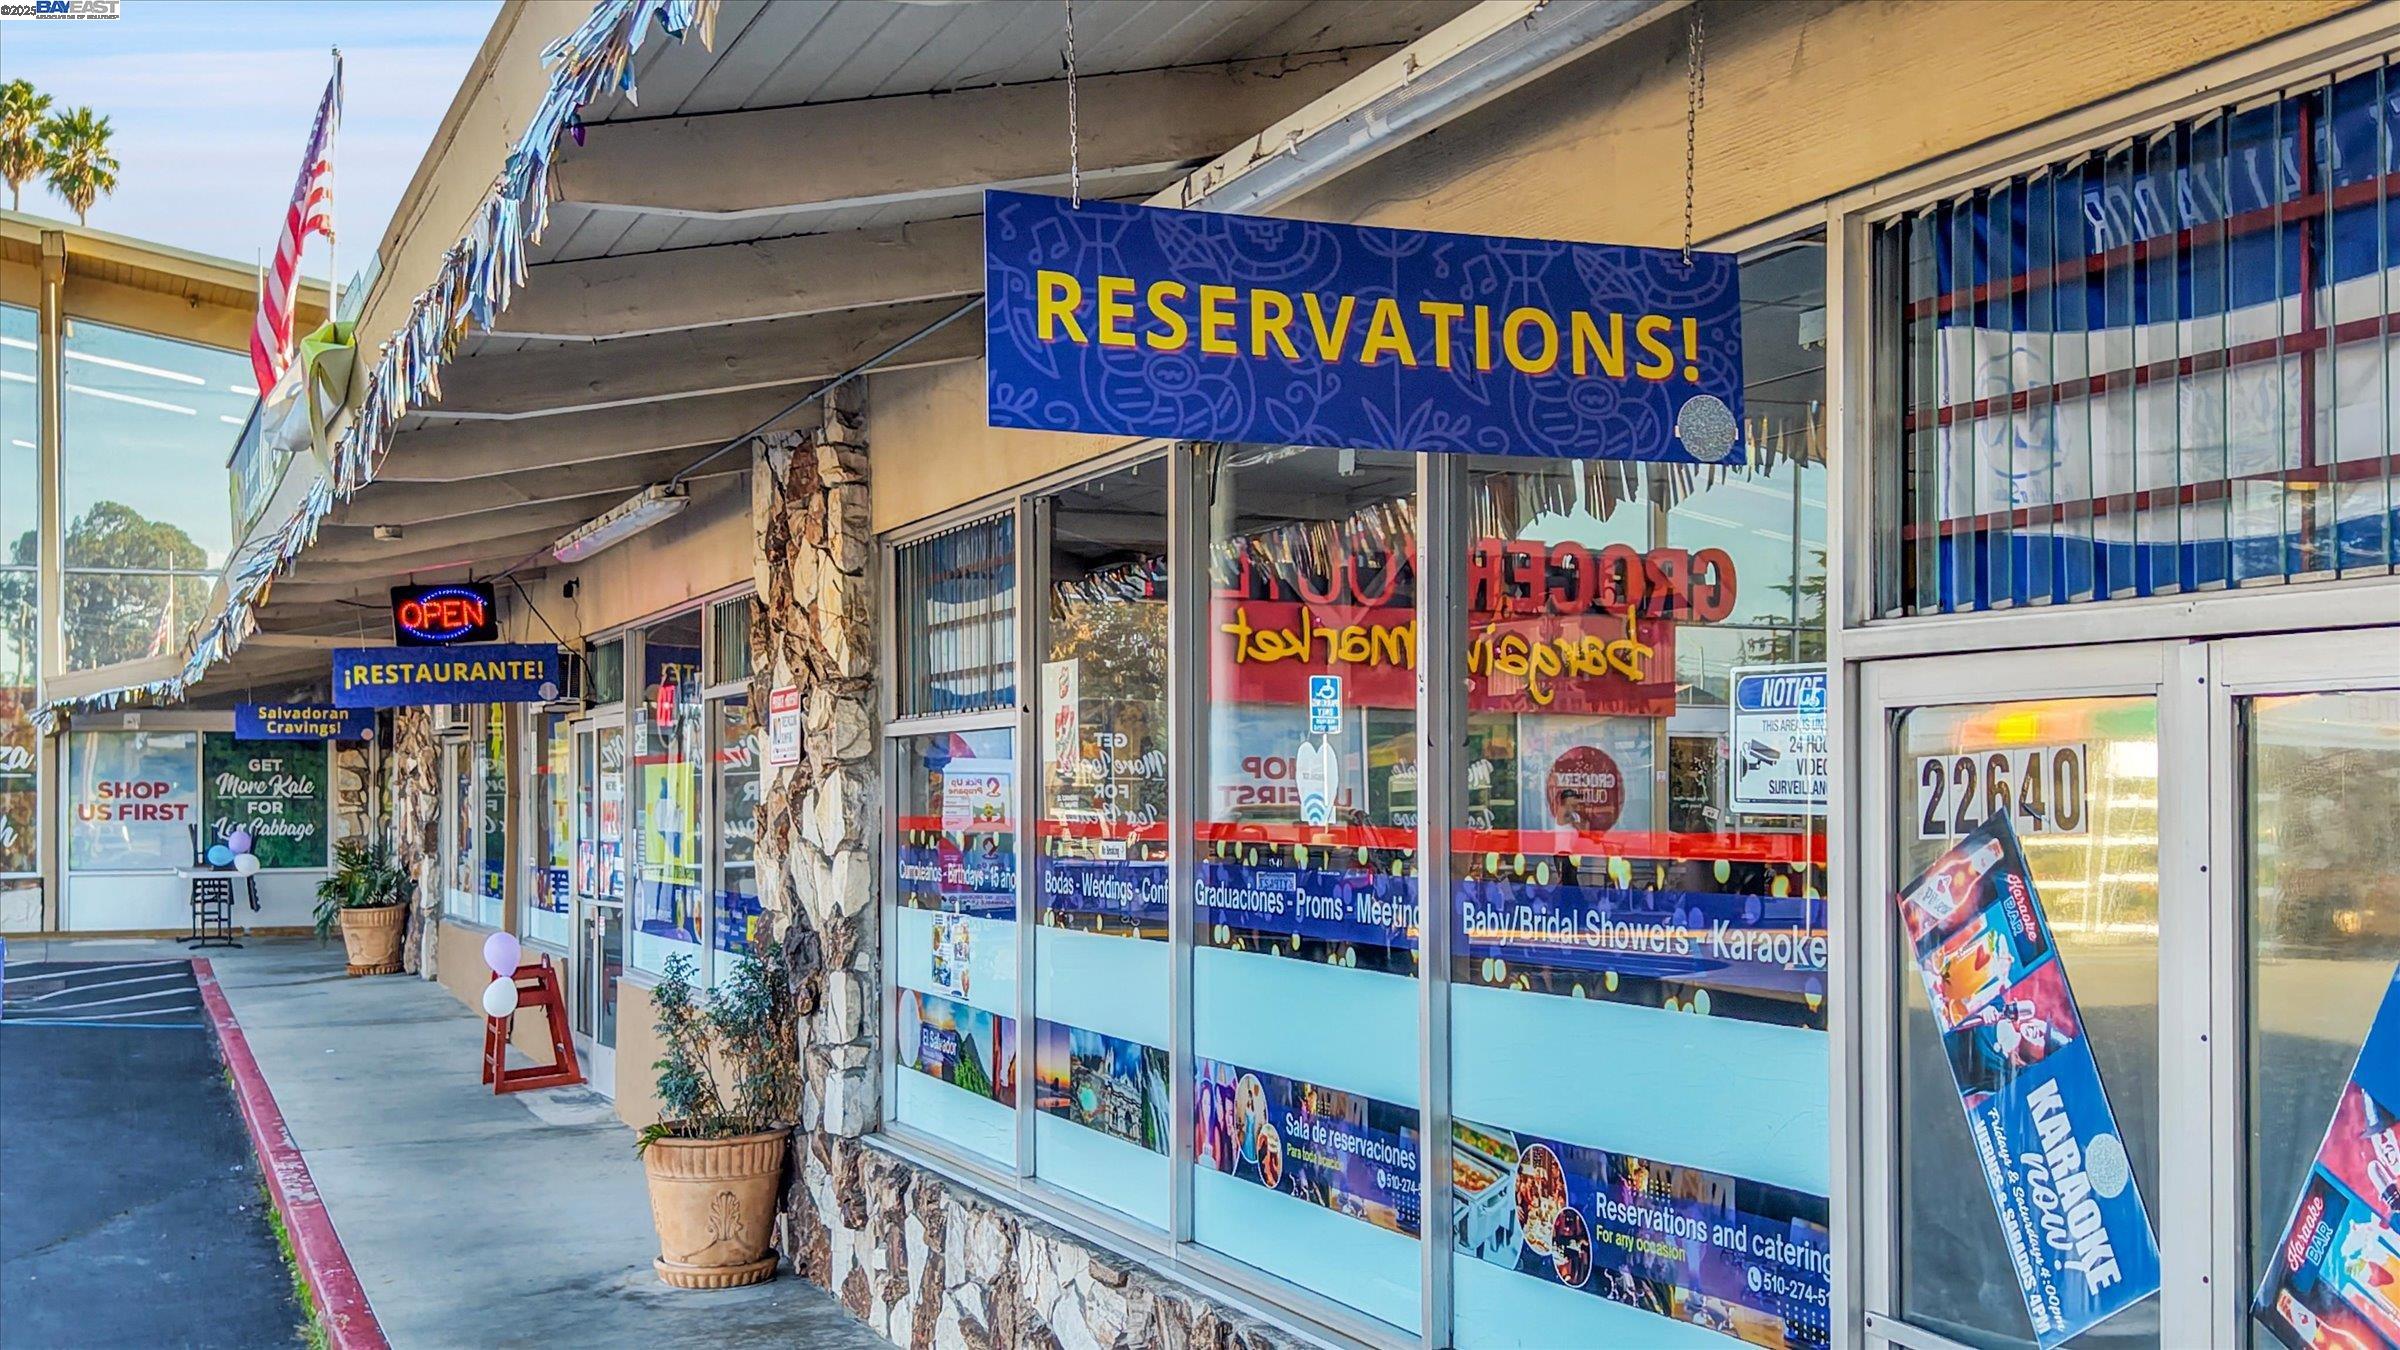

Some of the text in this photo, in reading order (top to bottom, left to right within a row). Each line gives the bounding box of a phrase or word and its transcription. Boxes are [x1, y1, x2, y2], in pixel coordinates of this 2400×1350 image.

[1037, 269, 1700, 384] RESERVATIONS!
[400, 599, 486, 630] OPEN
[344, 659, 544, 690] ¡RESTAURANTE!
[1761, 676, 1823, 707] NOTICE
[258, 706, 349, 720] Salvadoran
[266, 721, 341, 737] Cravings!
[1762, 719, 1778, 732] THIS
[1789, 736, 1803, 753] 24
[248, 758, 283, 772] GET
[98, 781, 170, 800] SHOP
[216, 772, 315, 798] More Kale
[1921, 747, 2081, 835] 22640
[78, 803, 189, 821] US FIRST
[247, 801, 284, 815] FOR
[947, 863, 984, 892] Birthdays
[990, 866, 999, 888] 15
[1045, 870, 1074, 895] Bodas
[1081, 872, 1133, 906] Weddings
[1194, 879, 1284, 915] Graduaciones
[1296, 888, 1343, 922] Proms
[2003, 896, 2025, 936] BAR
[2007, 873, 2037, 942] Karaoke
[1463, 900, 1578, 946] Baby/Bridal
[1586, 909, 1690, 955] Showers
[1712, 918, 1828, 968] Karaoke
[923, 1028, 929, 1046] El
[929, 1030, 957, 1055] Salvador
[1285, 1112, 1310, 1141] Sala
[1312, 1119, 1327, 1145] de
[1329, 1128, 1417, 1171] reservaciones
[1988, 1107, 2013, 1168] Fridays
[2007, 1171, 2020, 1184] &
[2026, 1078, 2122, 1296] KARAOKE
[1596, 1191, 1708, 1243] Reservations
[1712, 1224, 1748, 1253] and
[1973, 1119, 2004, 1187] VIERNES
[2002, 1208, 2037, 1291] SABADOS
[2028, 1293, 2052, 1335] 4PM
[2013, 1186, 2046, 1266] Saturdays
[2020, 1152, 2088, 1276] now!
[1596, 1224, 1687, 1263] For any occasion
[2286, 1195, 2324, 1272] Karaoke
[2305, 1221, 2333, 1267] BAR
